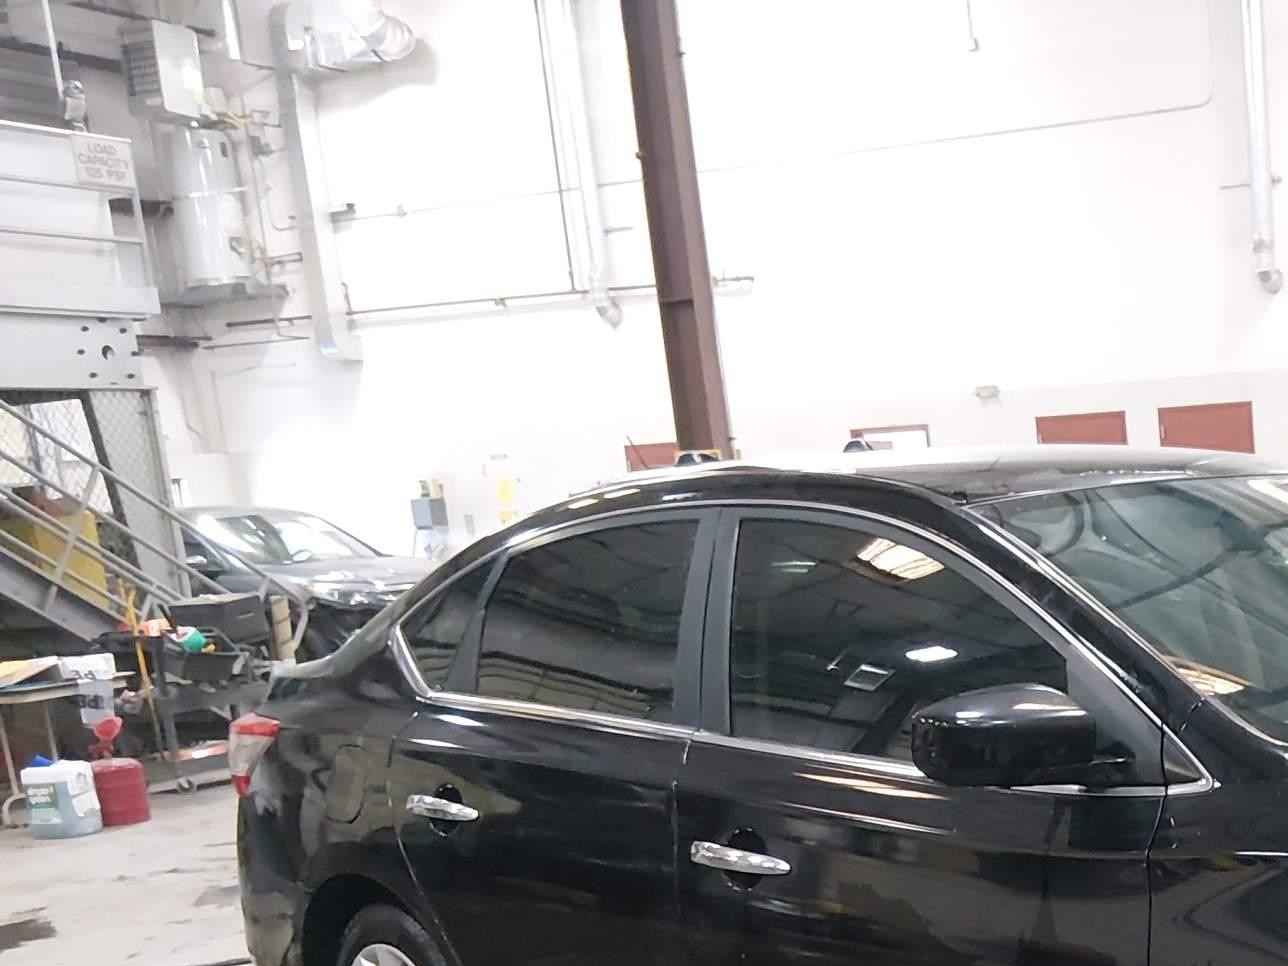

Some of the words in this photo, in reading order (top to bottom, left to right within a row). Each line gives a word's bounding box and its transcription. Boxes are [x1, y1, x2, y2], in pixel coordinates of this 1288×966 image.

[87, 142, 117, 156] LOAD
[78, 152, 129, 170] CAPACITY
[85, 166, 104, 179] 125
[106, 168, 127, 181] PSF
